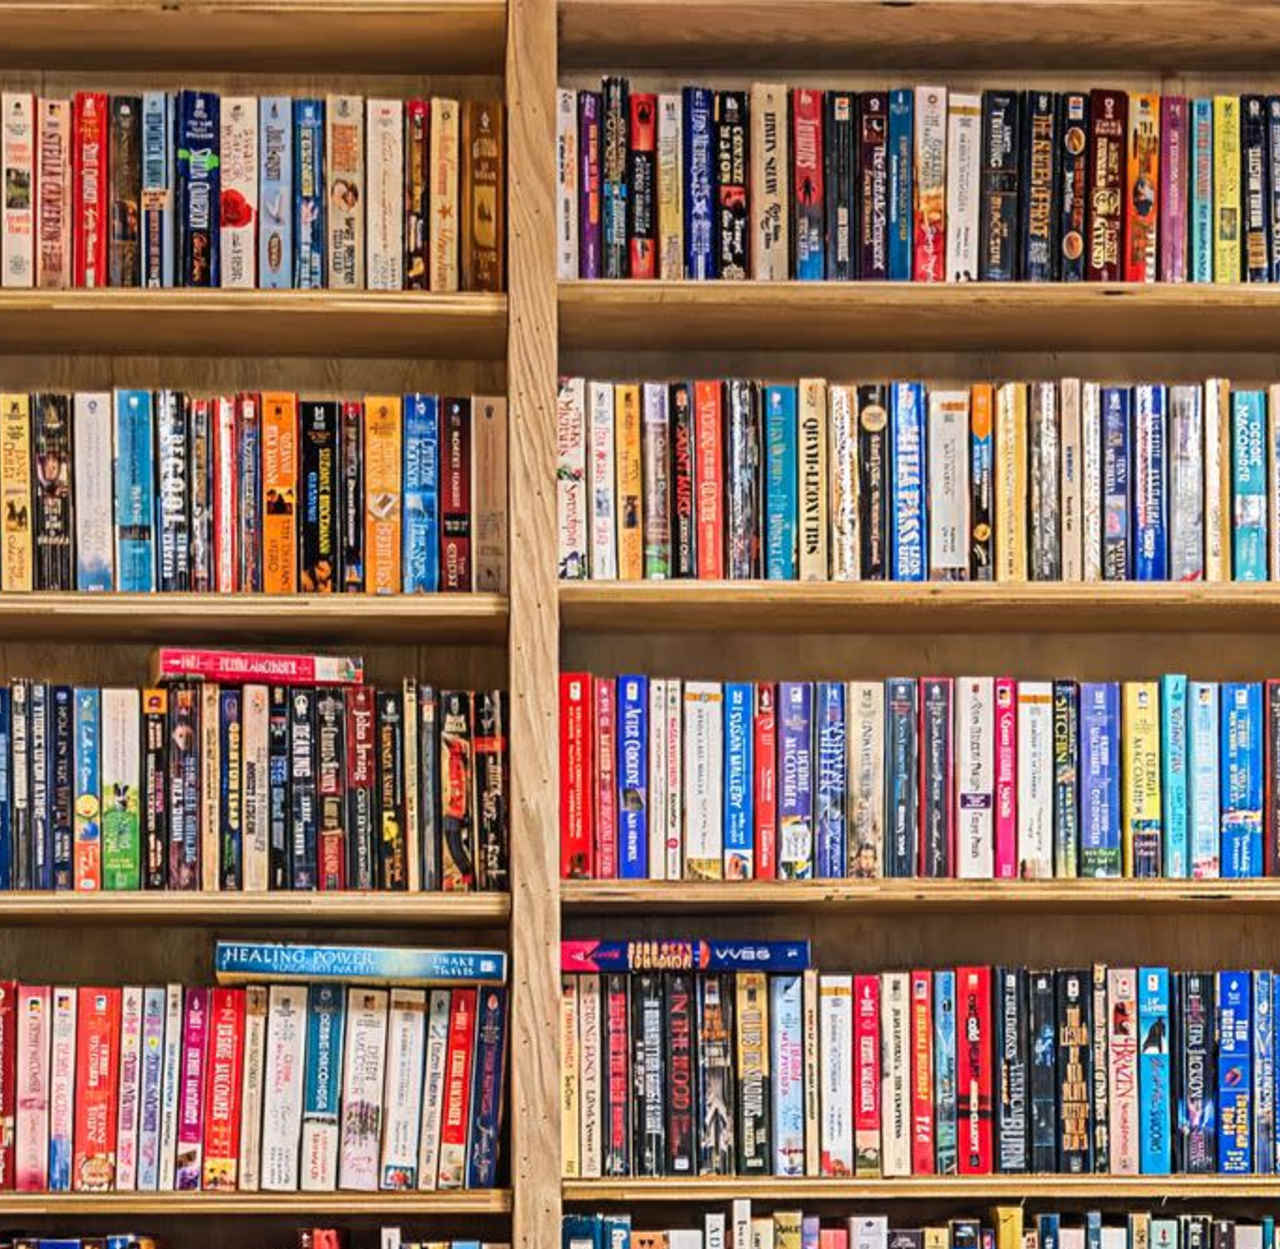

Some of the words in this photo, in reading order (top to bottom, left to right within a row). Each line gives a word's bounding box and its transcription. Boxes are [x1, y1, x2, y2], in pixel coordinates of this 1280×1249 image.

[355, 711, 370, 740] John
[355, 742, 368, 782] Irving
[225, 948, 305, 964] HEALING
[312, 951, 374, 965] POWER
[671, 994, 691, 1013] IN
[672, 1016, 691, 1050] THE
[1112, 1042, 1135, 1099] BRAZEN
[1000, 1118, 1024, 1168] BURN
